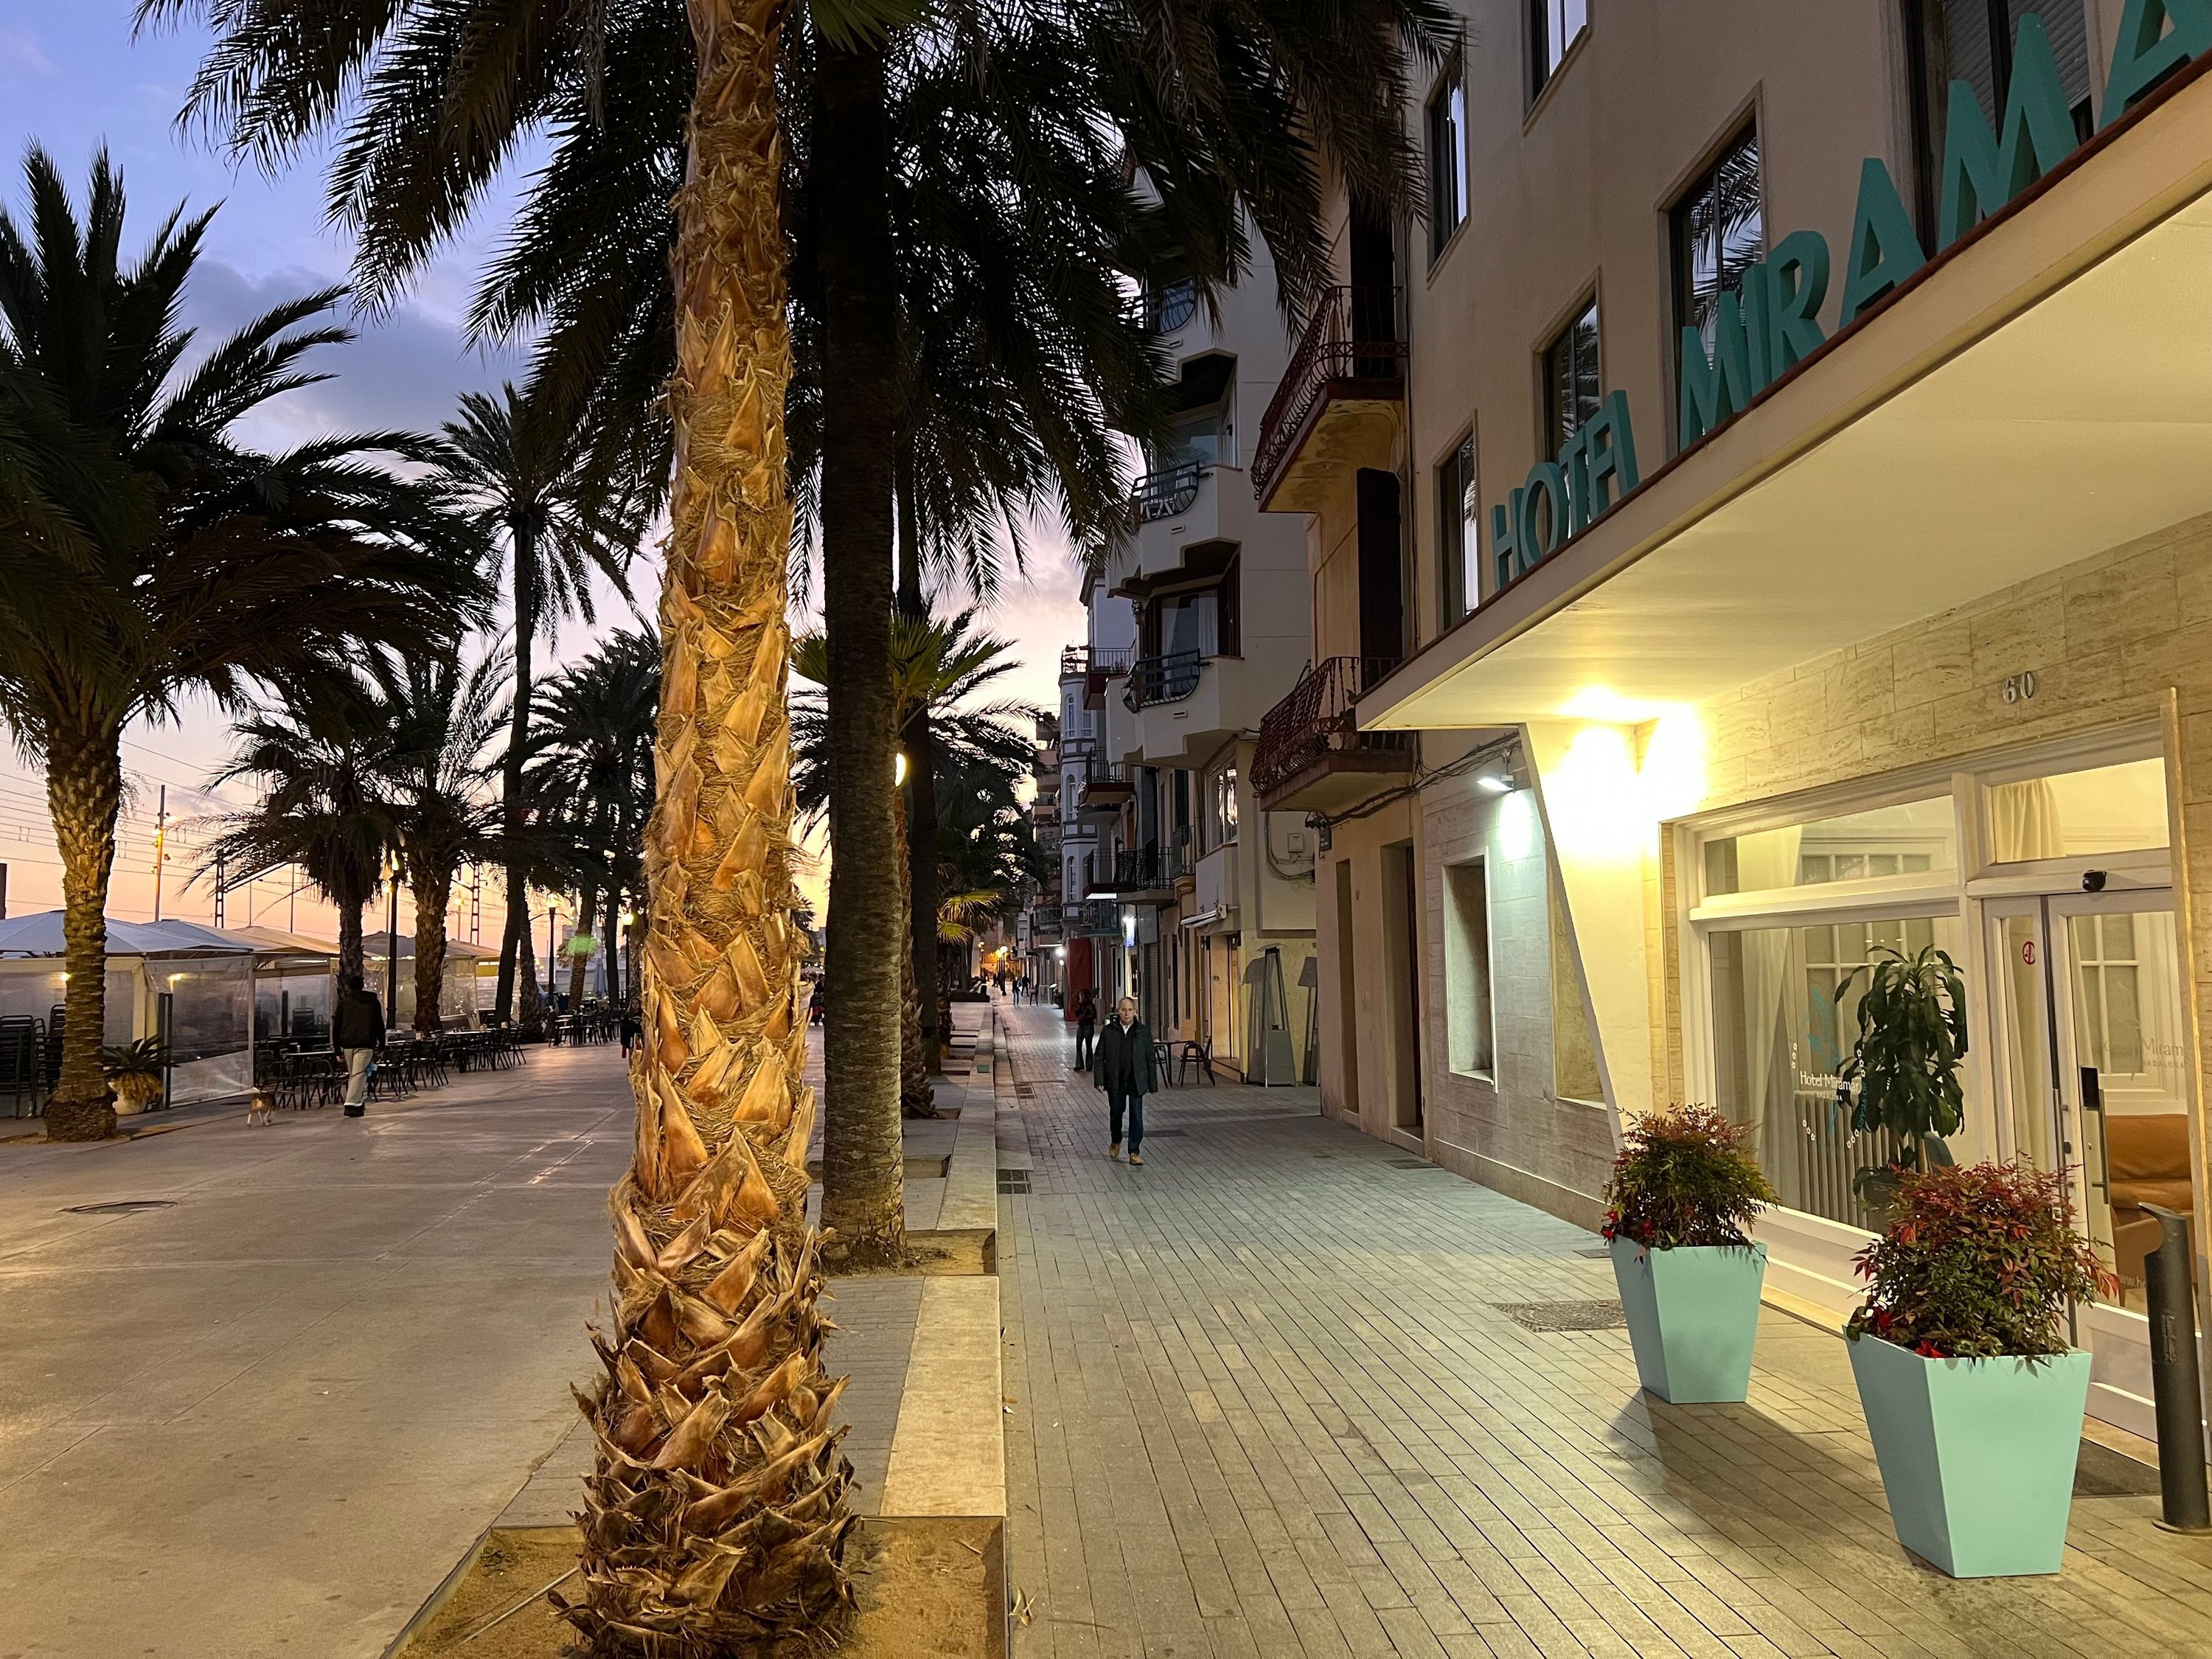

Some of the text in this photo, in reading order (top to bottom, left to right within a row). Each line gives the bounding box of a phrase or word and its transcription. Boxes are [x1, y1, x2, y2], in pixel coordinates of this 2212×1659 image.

[2003, 671, 2034, 704] 60
[1800, 1071, 1859, 1091] Hotel Miramar
